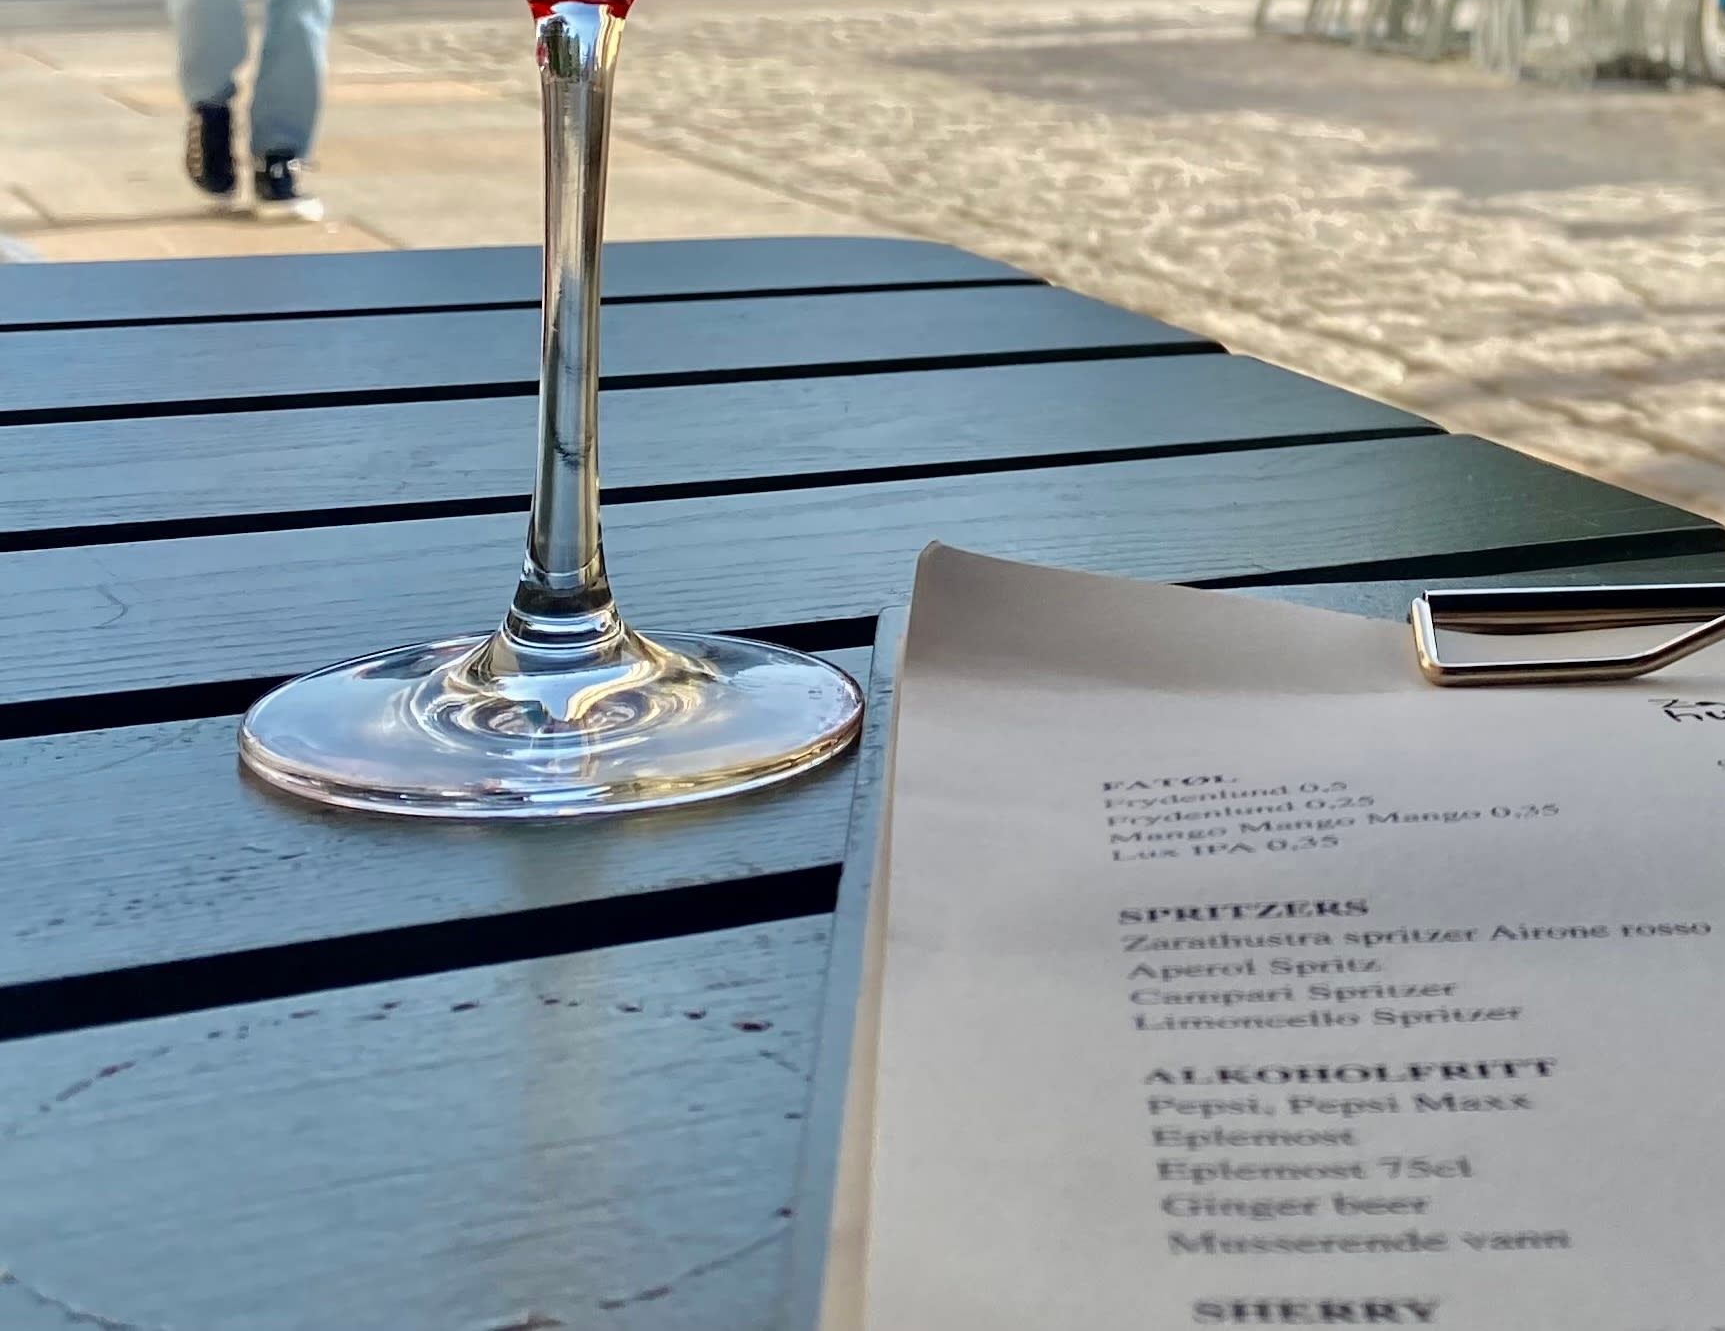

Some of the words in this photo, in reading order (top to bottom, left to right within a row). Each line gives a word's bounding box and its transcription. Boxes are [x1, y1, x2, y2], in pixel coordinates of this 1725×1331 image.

[1104, 785, 1288, 809] Frydenlund
[1107, 801, 1295, 826] Frydenlund
[1109, 826, 1228, 844] Mango
[1240, 818, 1355, 834] Mango
[1366, 811, 1481, 825] Mango
[1192, 842, 1256, 856] IPA
[1118, 899, 1369, 925] SPRITZERS
[1120, 932, 1333, 952] Zarathustra
[1344, 925, 1478, 948] spritzer
[1490, 922, 1610, 941] Airone
[1620, 921, 1711, 938] rosso
[1128, 958, 1256, 982] Aperol
[1269, 956, 1381, 978] Spritz
[1128, 981, 1294, 1007] Campari
[1303, 980, 1458, 1002] Spritzer
[1132, 1009, 1360, 1031] Limoncello
[1372, 1005, 1522, 1028] Spritzer
[1144, 1058, 1557, 1084] ALKOHOLFRITT
[1288, 1093, 1401, 1118] Pepsi
[1151, 1125, 1360, 1151] Eplemost
[1155, 1157, 1368, 1185] Eplemost
[1159, 1192, 1321, 1221] Ginger
[1331, 1192, 1430, 1216] beer
[1167, 1228, 1449, 1255] Musserende
[1458, 1229, 1572, 1251] vann
[1192, 1297, 1440, 1325] SHERRY
